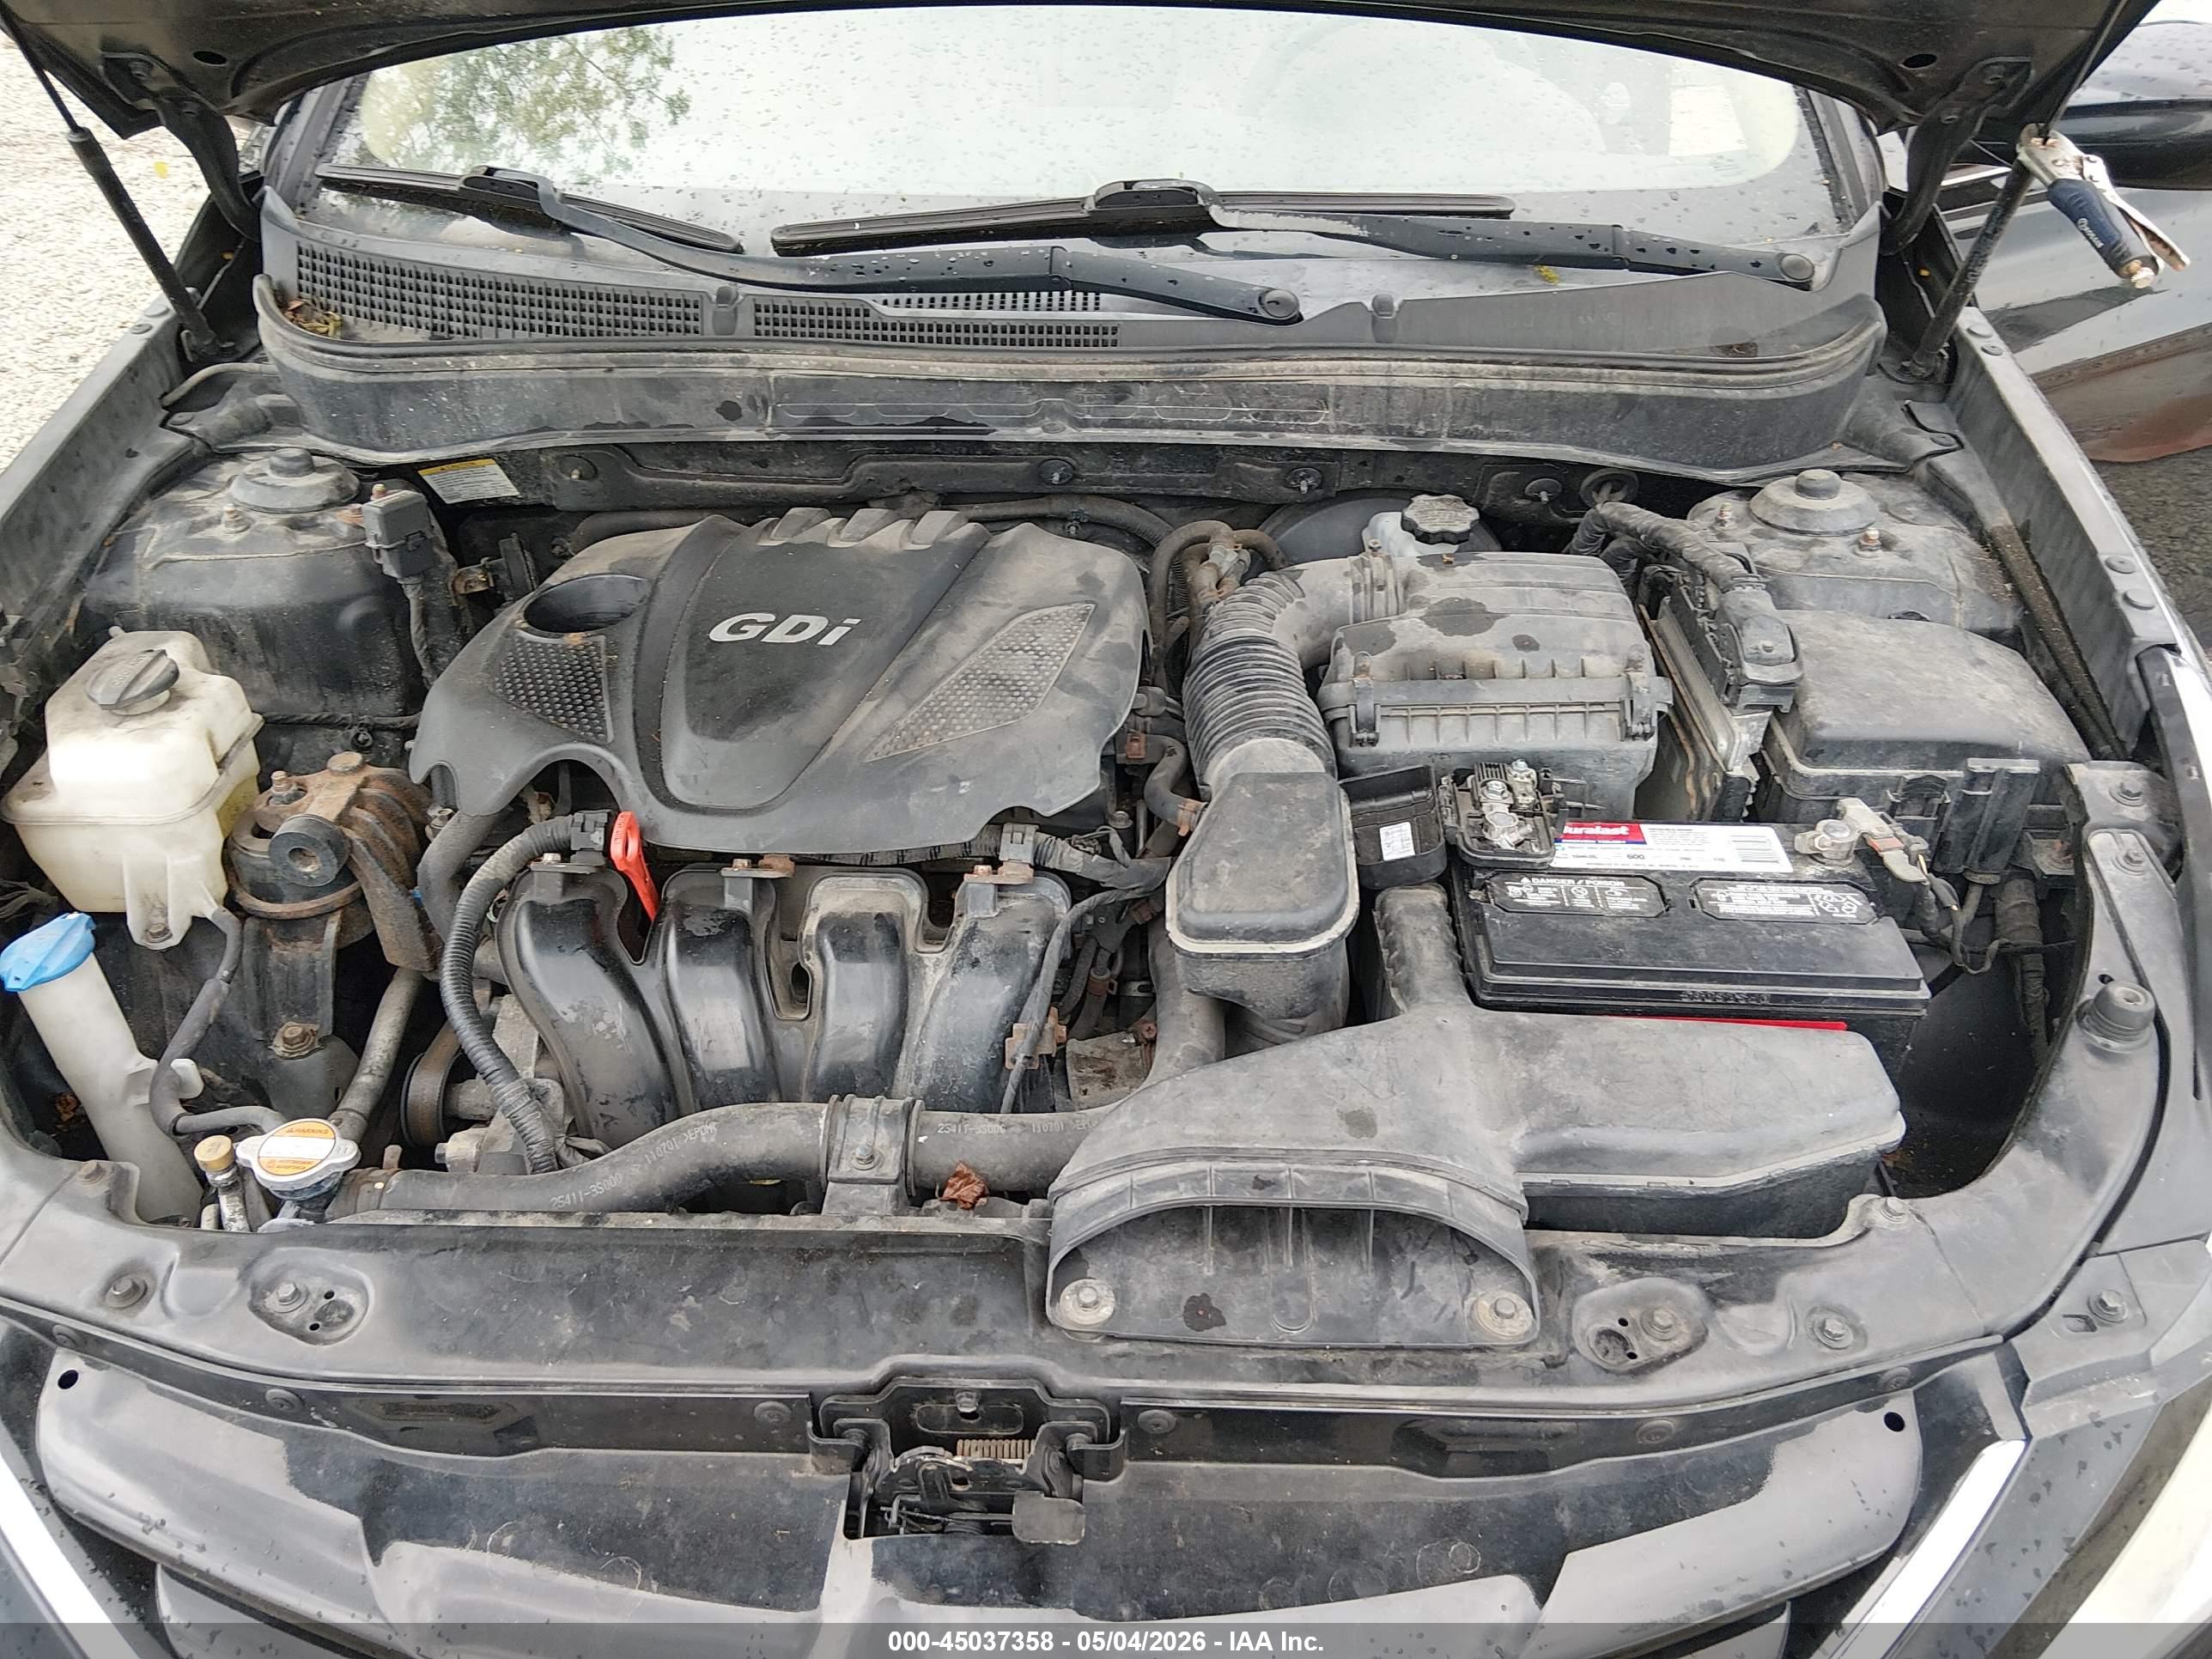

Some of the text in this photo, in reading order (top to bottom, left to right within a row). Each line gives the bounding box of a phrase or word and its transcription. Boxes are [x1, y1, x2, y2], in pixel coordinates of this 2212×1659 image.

[708, 612, 862, 646] GDi
[1531, 877, 1576, 885] DANGER
[1585, 878, 1626, 888] POISON
